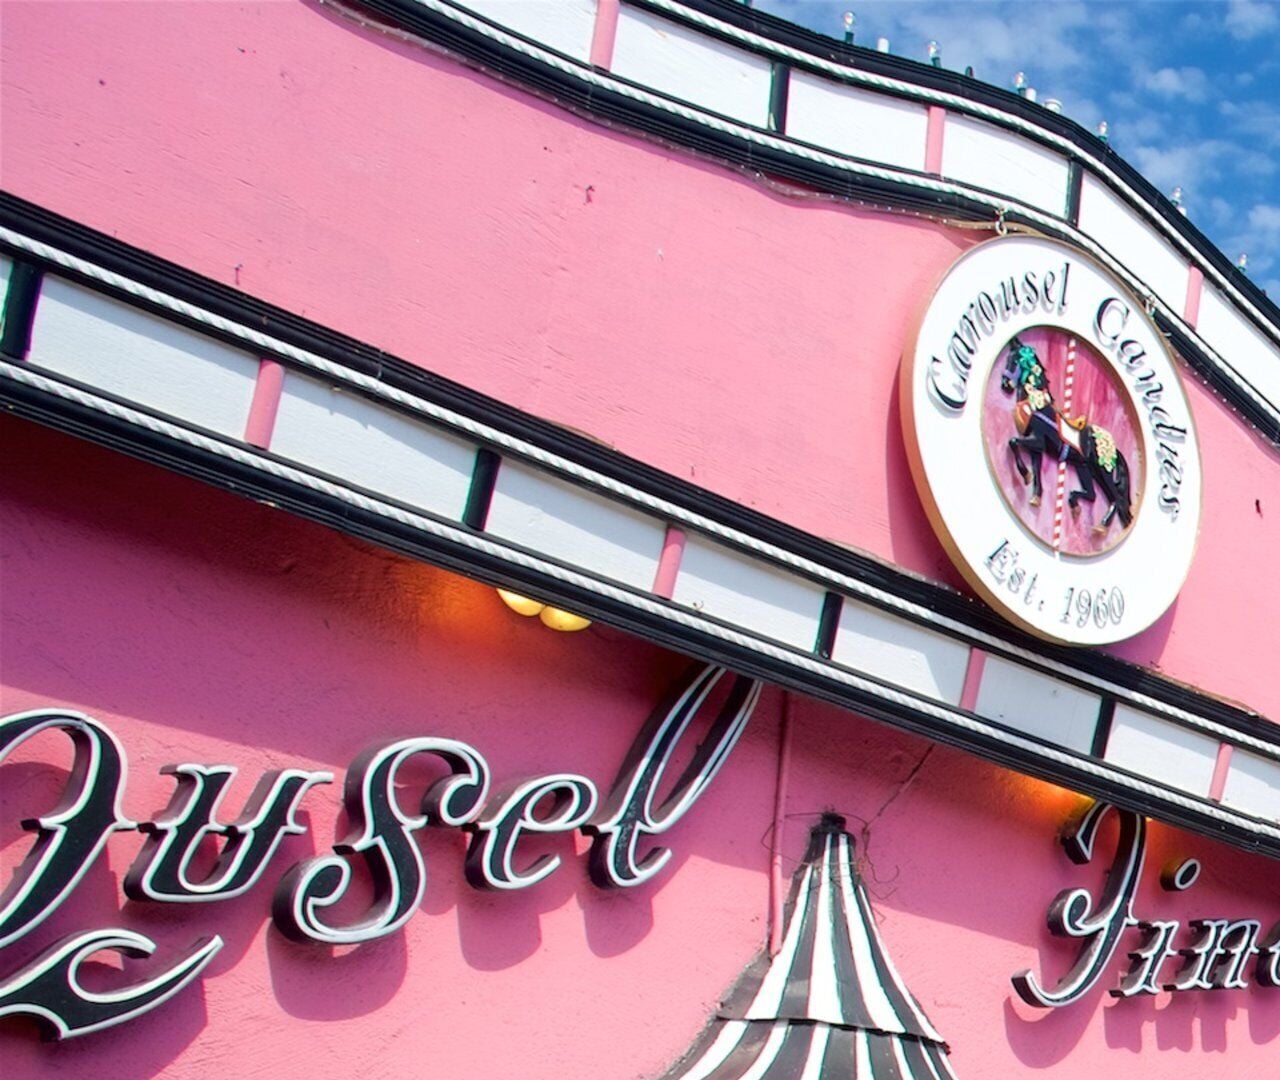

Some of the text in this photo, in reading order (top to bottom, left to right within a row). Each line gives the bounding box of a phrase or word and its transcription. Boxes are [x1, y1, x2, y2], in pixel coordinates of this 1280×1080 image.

[927, 262, 1188, 522] Carousel Candies
[984, 539, 1124, 629] Est. 1960
